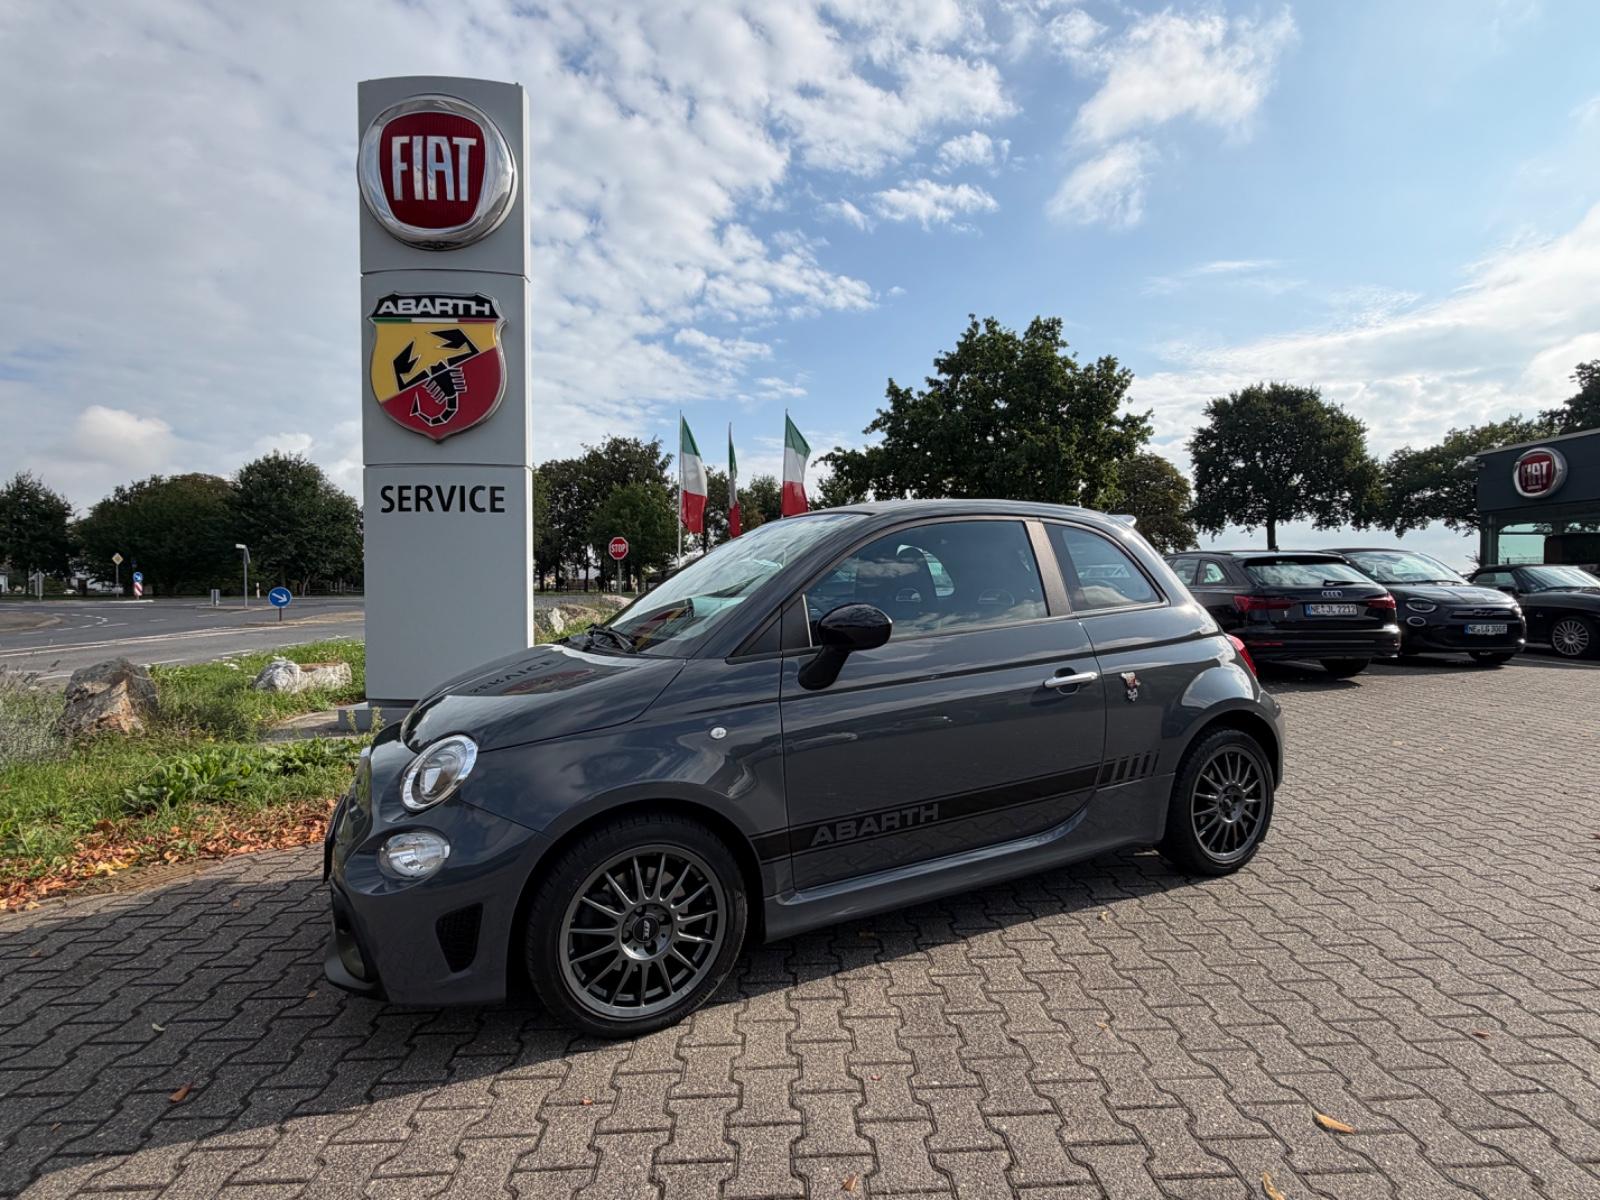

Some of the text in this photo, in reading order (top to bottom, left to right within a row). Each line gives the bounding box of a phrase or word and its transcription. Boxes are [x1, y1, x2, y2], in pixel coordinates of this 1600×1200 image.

[391, 136, 477, 202] FIAT
[377, 298, 491, 316] ABARTH
[1521, 461, 1550, 487] FIAT
[380, 484, 505, 514] SERVICE
[611, 543, 626, 553] STOP
[810, 803, 938, 847] ABARTH
